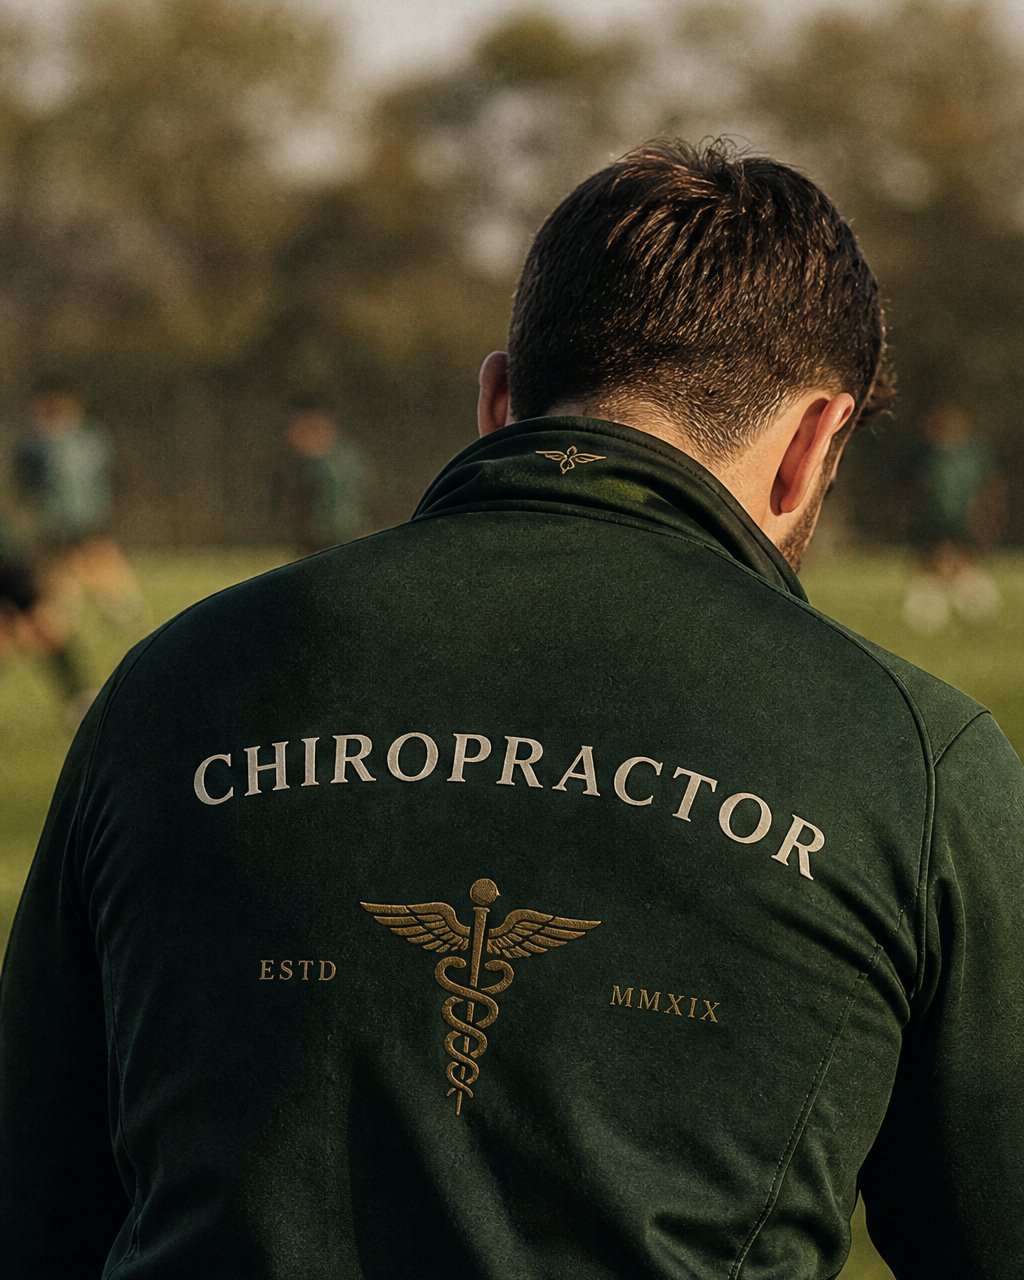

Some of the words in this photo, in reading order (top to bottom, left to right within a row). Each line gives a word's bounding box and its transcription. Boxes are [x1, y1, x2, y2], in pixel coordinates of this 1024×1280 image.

[194, 731, 826, 881] CHIROPRACTOR
[259, 959, 337, 981] ESTD
[609, 984, 720, 1023] MMXIX
